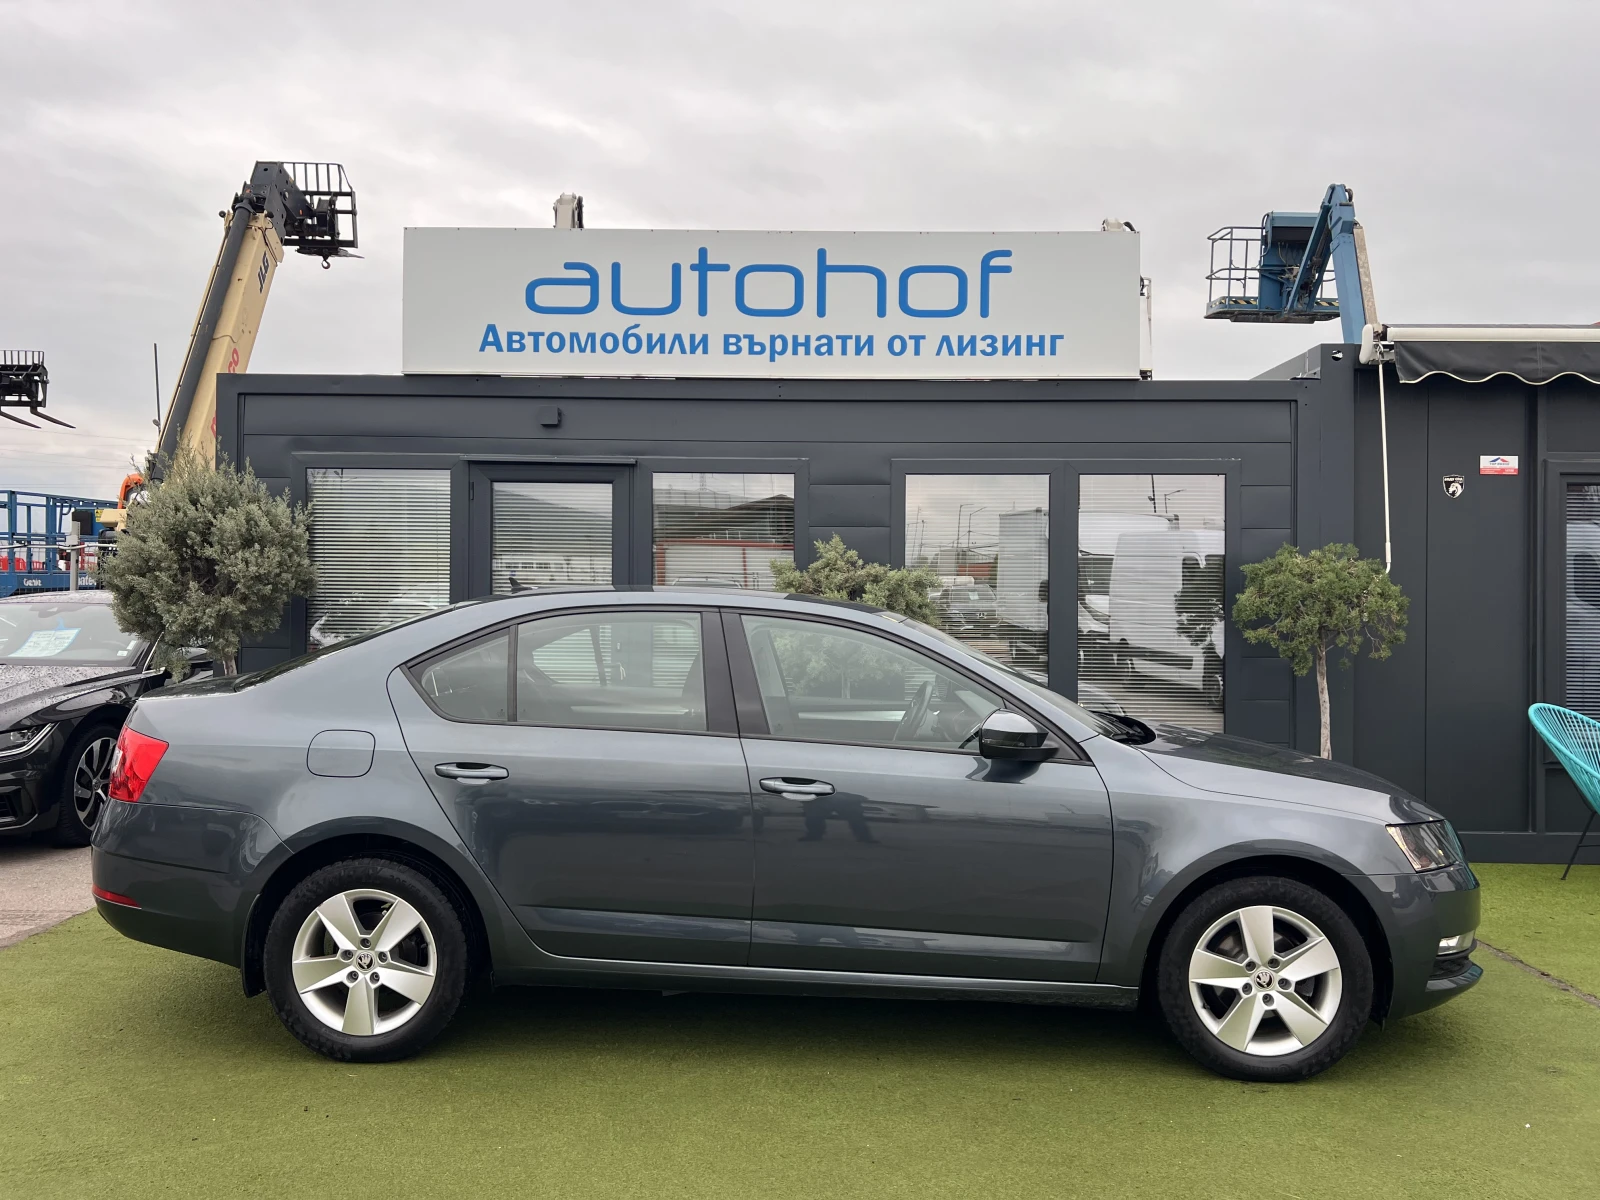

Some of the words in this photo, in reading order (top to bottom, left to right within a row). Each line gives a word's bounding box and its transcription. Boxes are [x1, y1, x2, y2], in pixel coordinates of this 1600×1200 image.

[526, 247, 1012, 318] autohof
[480, 323, 708, 355] Автомобили
[724, 334, 874, 362] върнати
[888, 335, 926, 356] от
[936, 335, 1064, 356] лизинг
